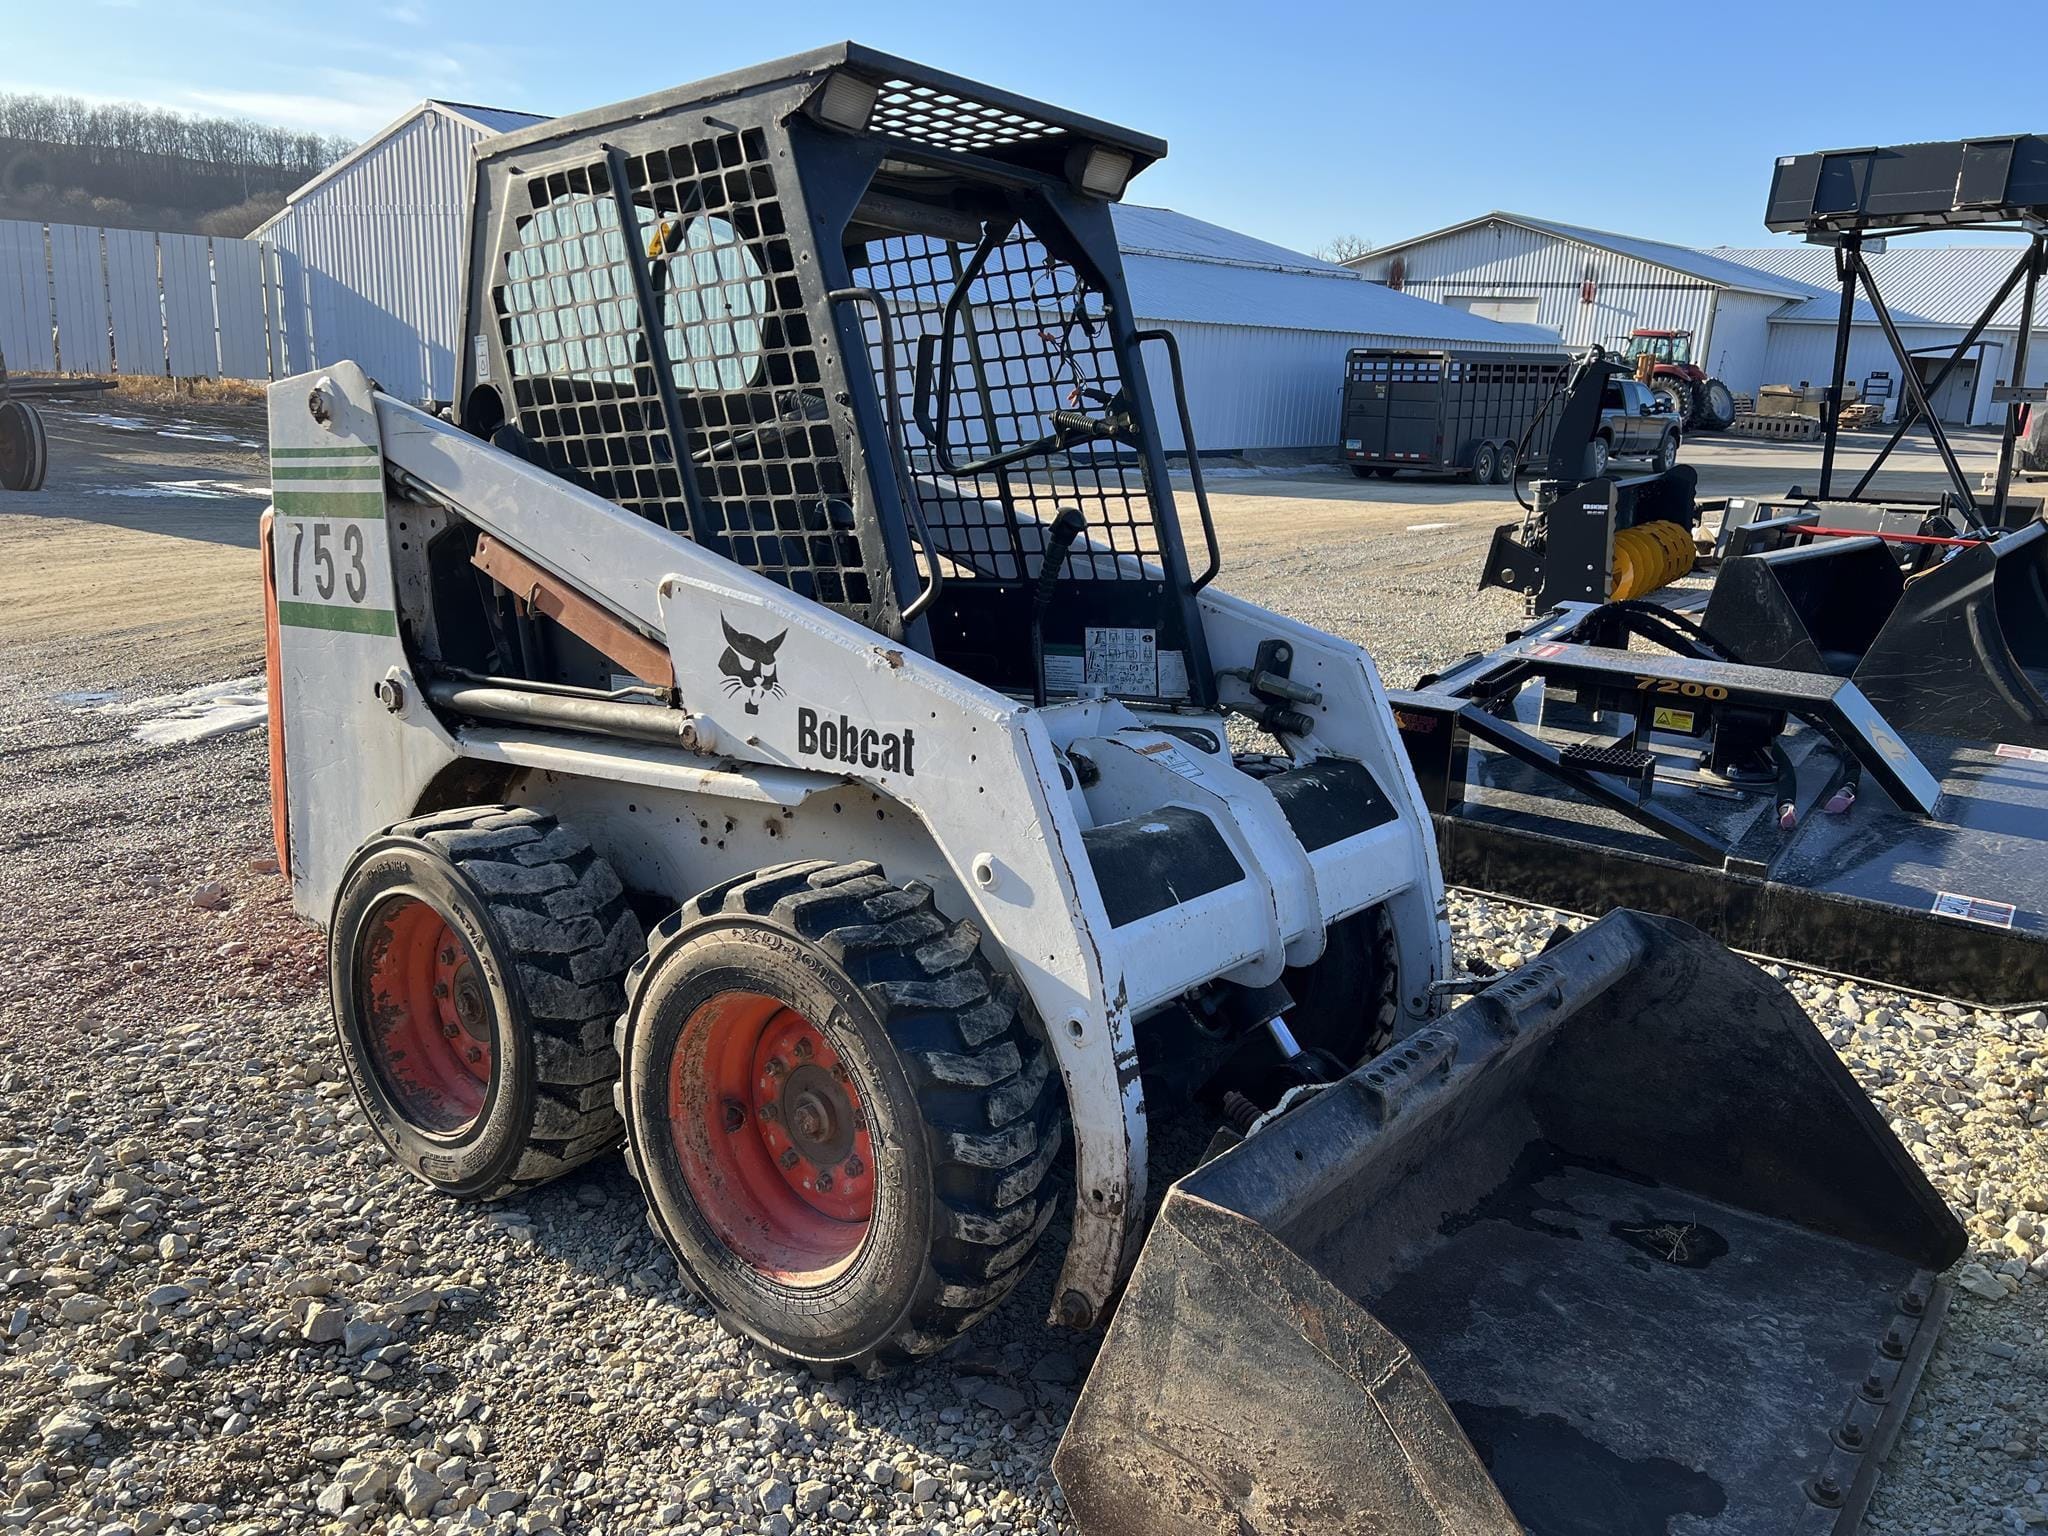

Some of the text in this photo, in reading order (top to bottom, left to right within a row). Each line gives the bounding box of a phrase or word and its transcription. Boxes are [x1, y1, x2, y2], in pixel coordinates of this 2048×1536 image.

[292, 523, 367, 604] 753
[1634, 675, 1729, 701] 7200
[798, 706, 915, 777] Bobcat
